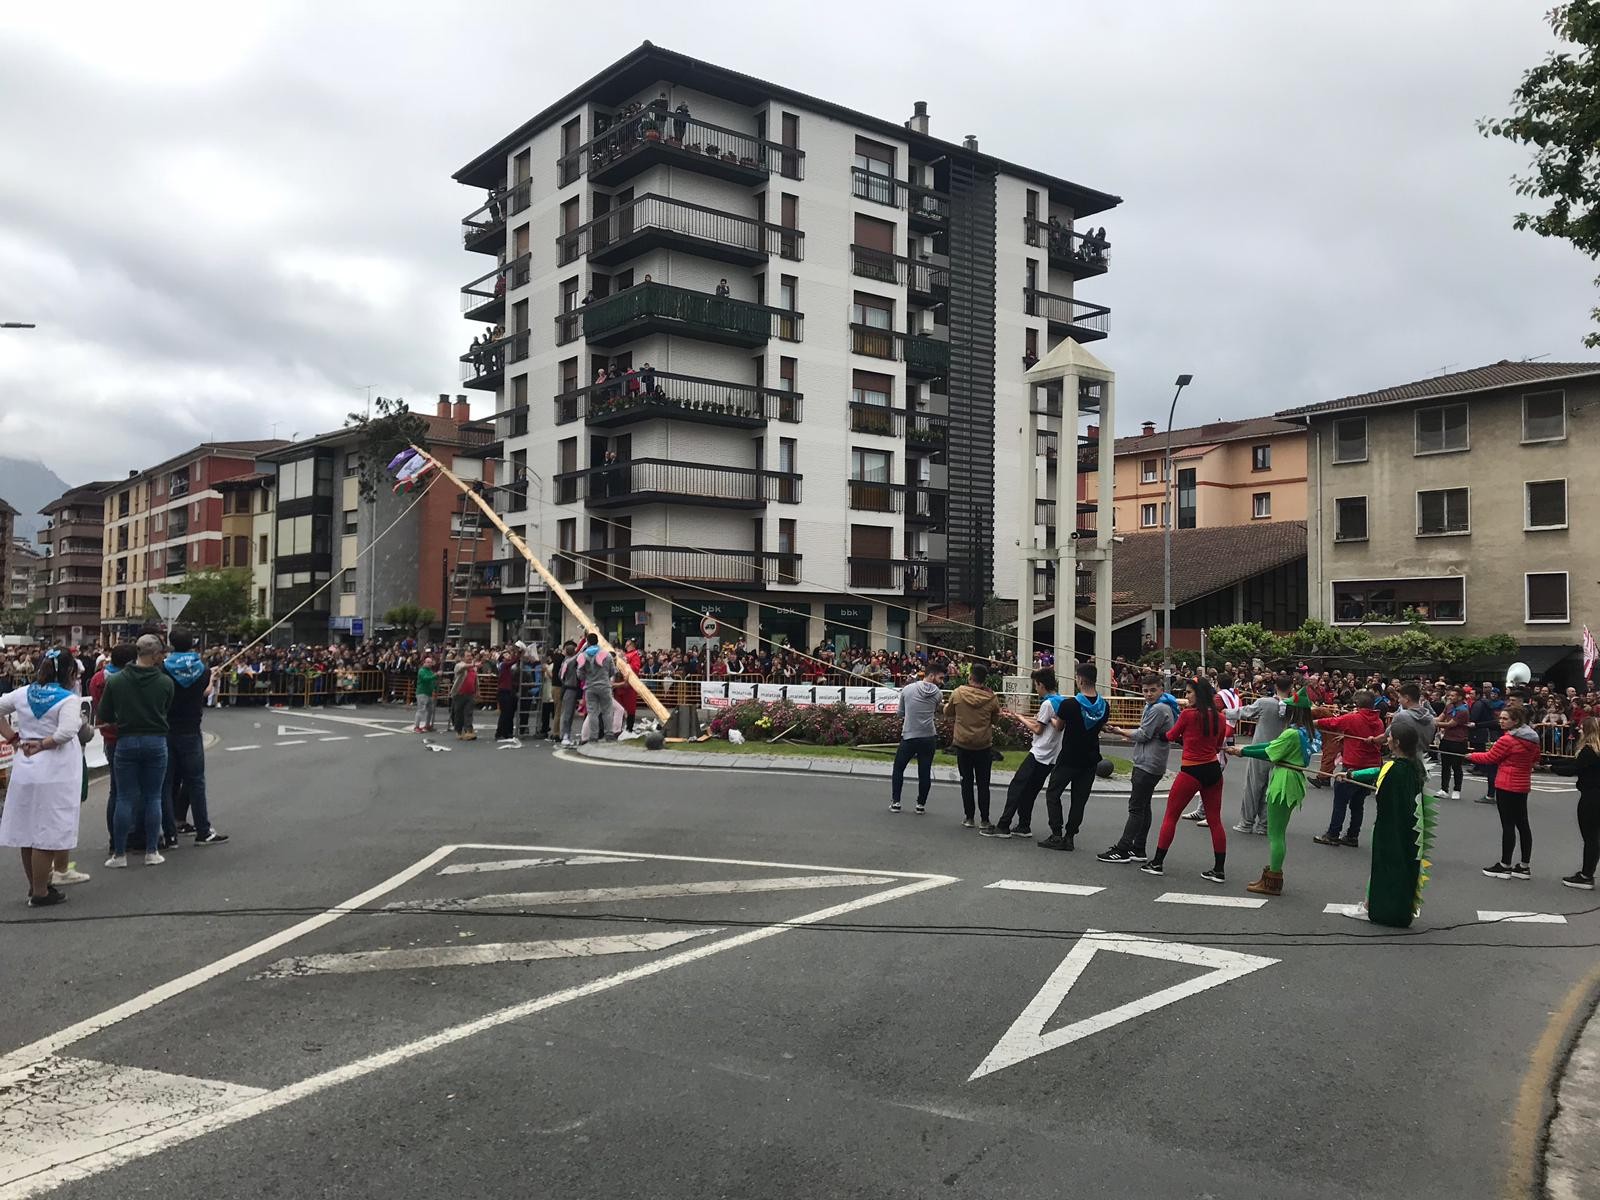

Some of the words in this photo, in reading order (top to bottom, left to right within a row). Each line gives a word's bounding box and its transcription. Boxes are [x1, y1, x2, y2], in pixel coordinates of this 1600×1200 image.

[611, 605, 624, 613] bbk
[701, 605, 721, 613] bbk
[722, 682, 729, 698] 1
[750, 683, 758, 699] 1
[779, 685, 788, 700] 1
[808, 687, 816, 704] 1
[837, 687, 846, 703] 1
[867, 687, 876, 704] 1
